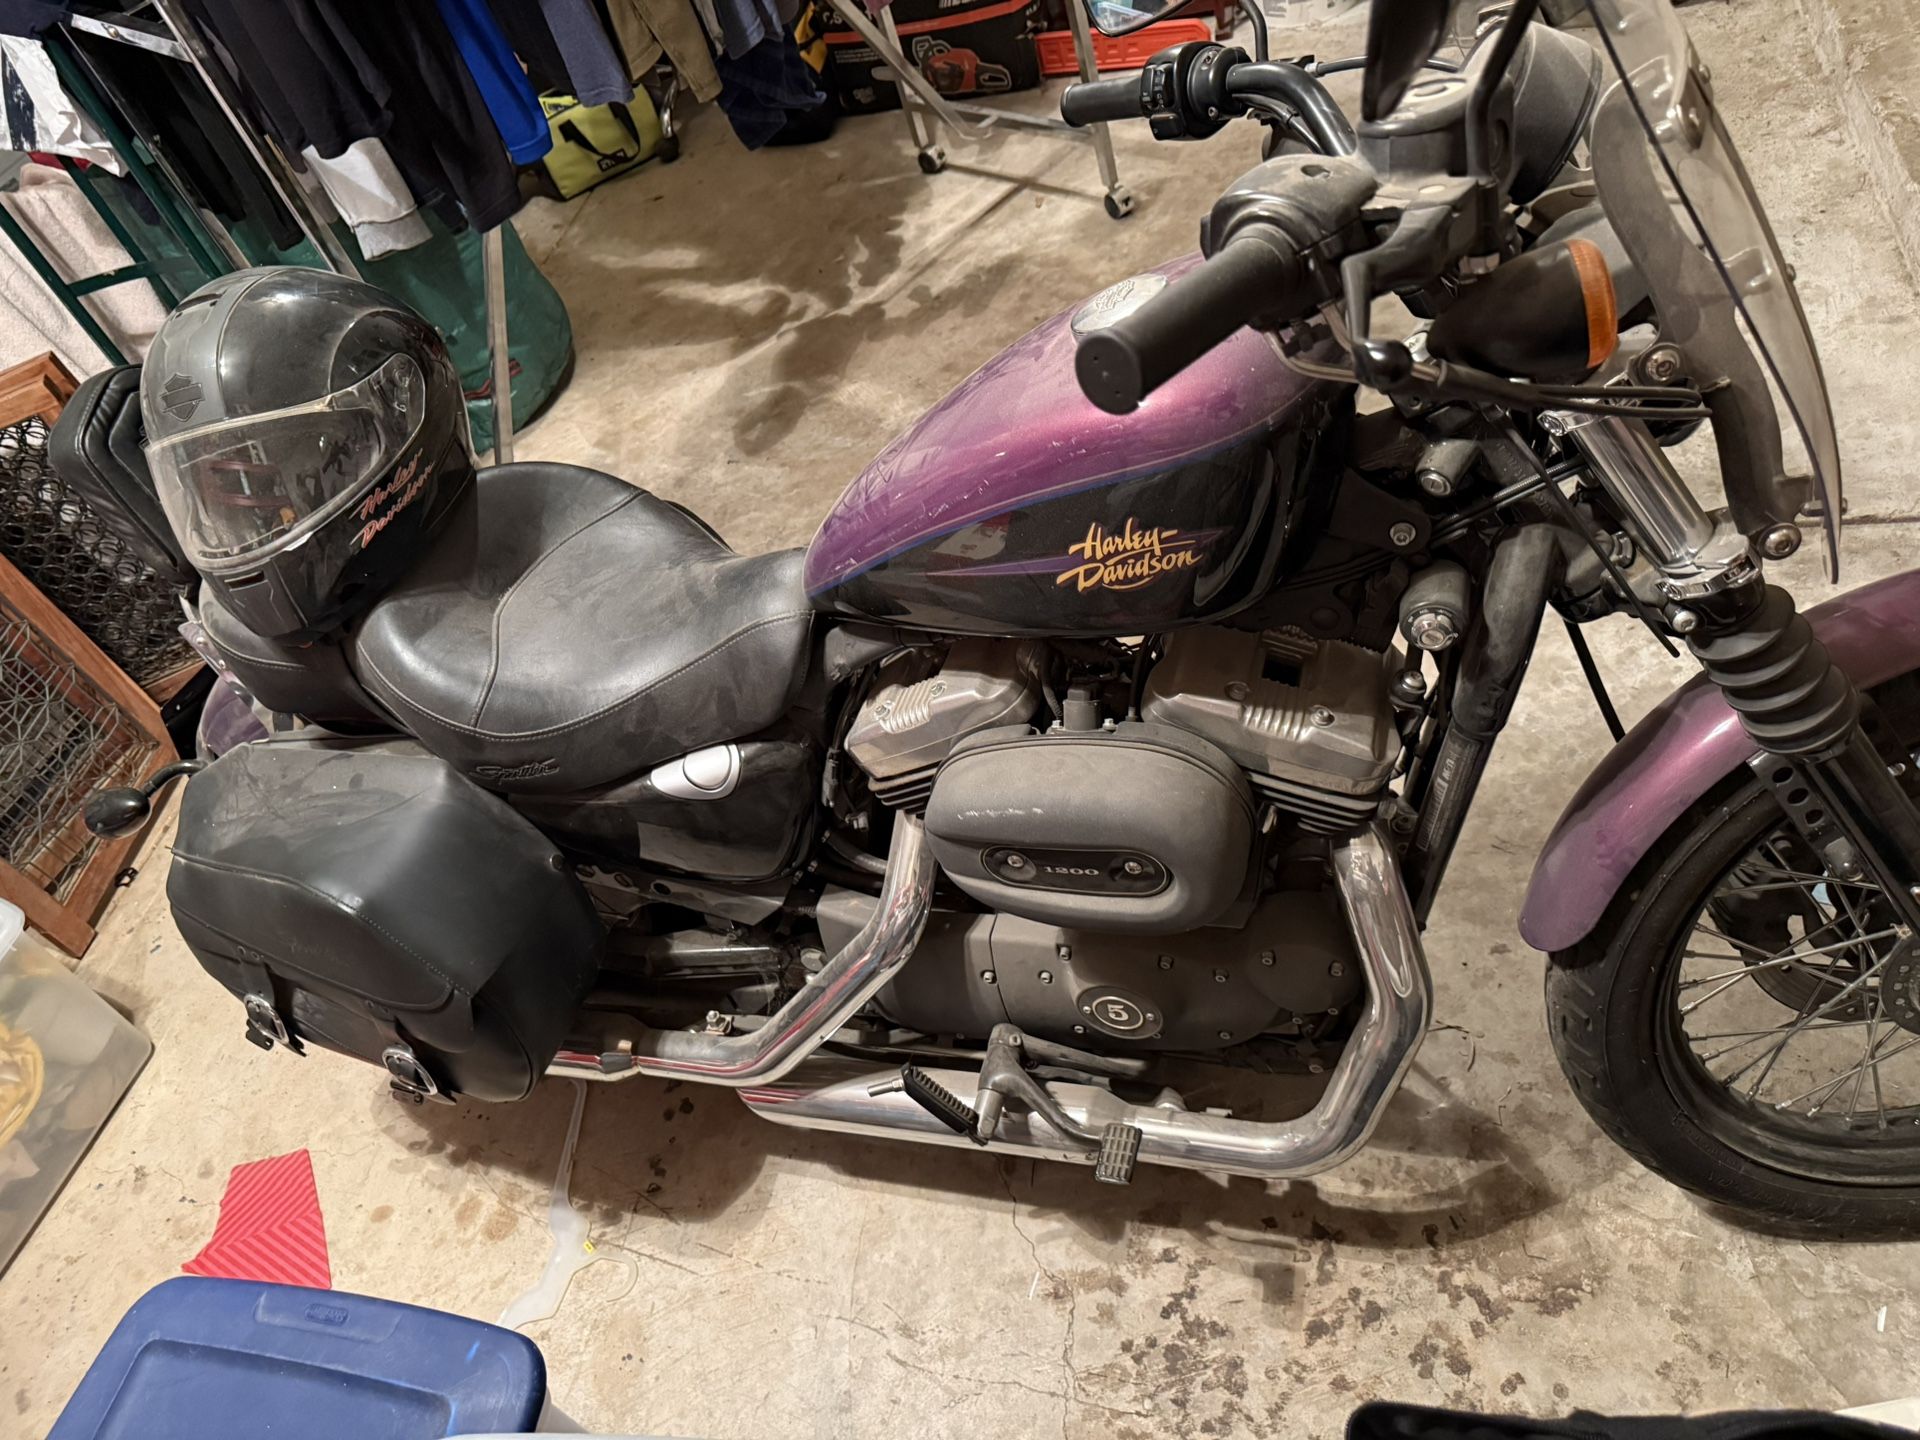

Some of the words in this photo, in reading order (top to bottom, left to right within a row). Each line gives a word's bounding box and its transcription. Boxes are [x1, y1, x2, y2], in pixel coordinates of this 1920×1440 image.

[1068, 517, 1178, 560] Harley-
[1056, 549, 1203, 592] Davidson
[1043, 866, 1099, 876] 1200
[1107, 1003, 1129, 1021] 5
